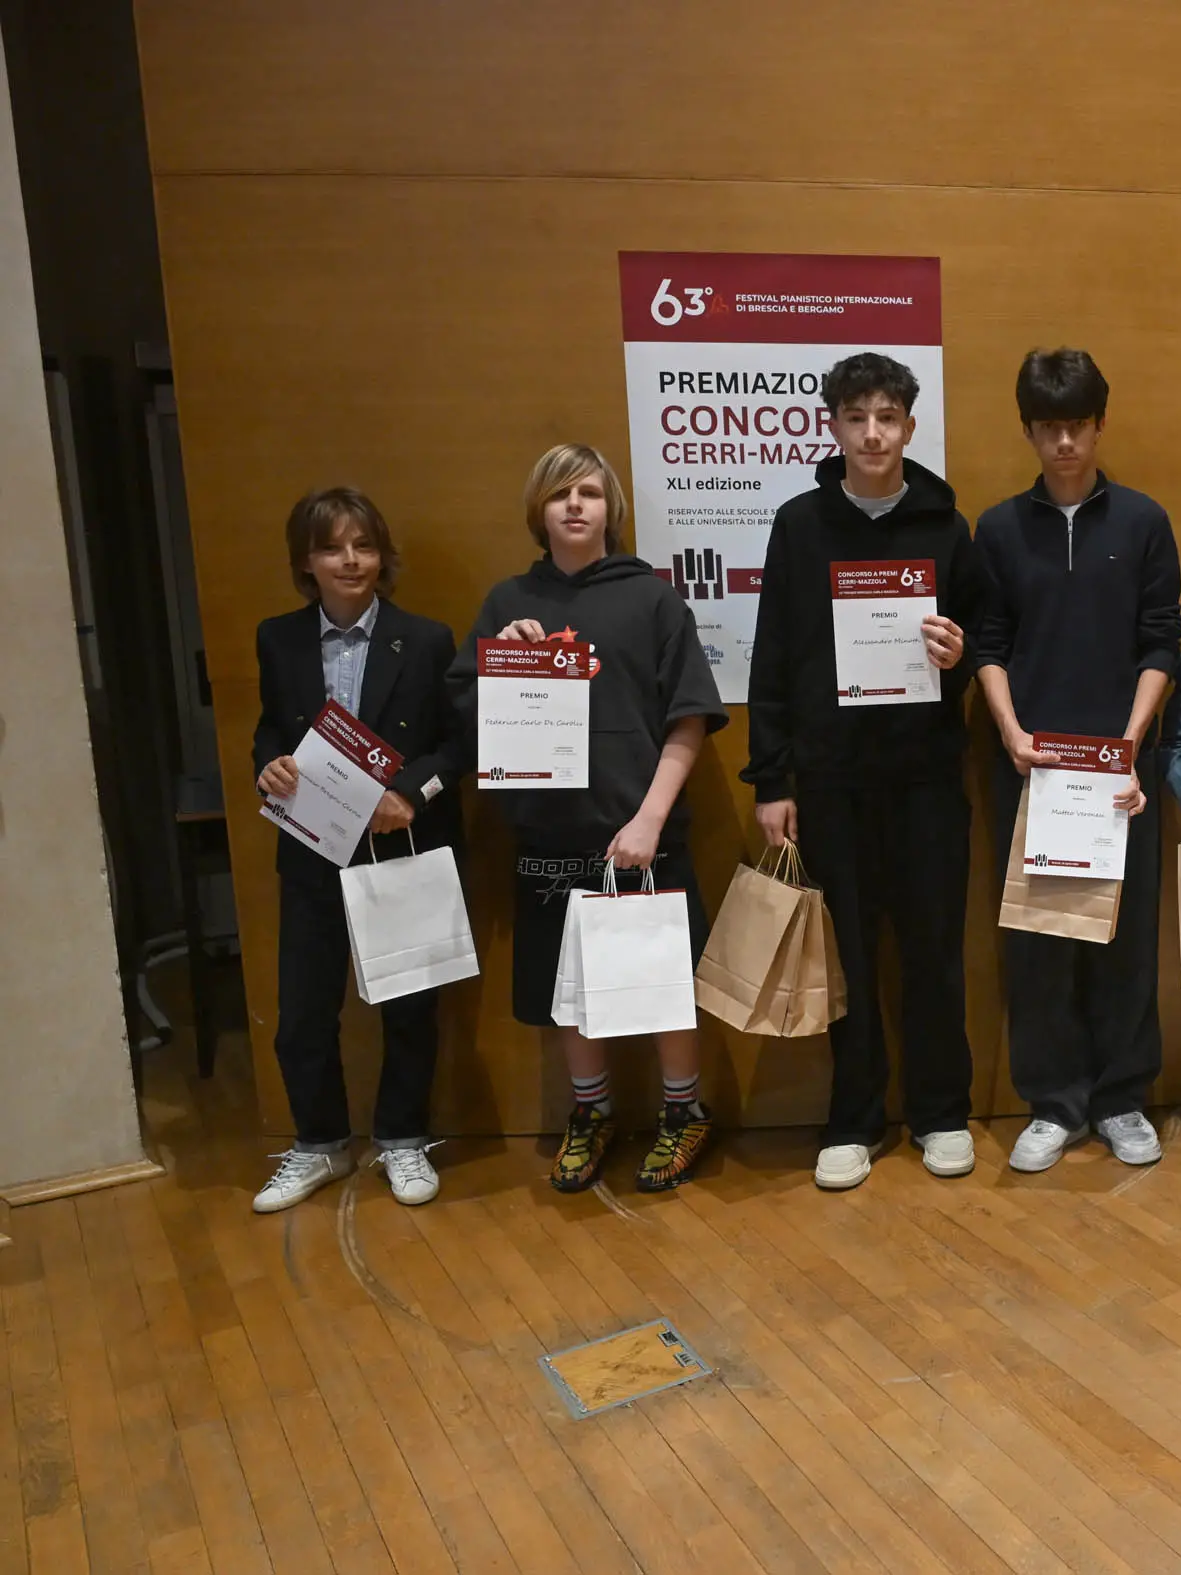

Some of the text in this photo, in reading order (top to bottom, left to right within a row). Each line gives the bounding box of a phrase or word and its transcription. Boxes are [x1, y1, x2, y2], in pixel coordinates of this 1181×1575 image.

[736, 294, 913, 305] FESTIVAL PIANISTICO INTERNAZIONALE
[748, 305, 788, 313] BRESCIA
[797, 305, 845, 314] BERGAMO
[661, 442, 846, 465] CERRI-MAZZ
[666, 478, 762, 490] XLI edizione
[668, 508, 714, 516] RISERVATO
[715, 508, 735, 516] ALLE
[697, 517, 746, 526] UNIVERSITÀ
[486, 649, 524, 657] CONCORSO
[486, 656, 539, 664] CERRI-MAZZOLA
[323, 716, 359, 748] CERRI-MAZZOLA
[327, 709, 353, 733] CONCORSO
[355, 732, 371, 748] PREMI
[1039, 742, 1073, 750] CONCORSO
[326, 761, 349, 780] PREMIO
